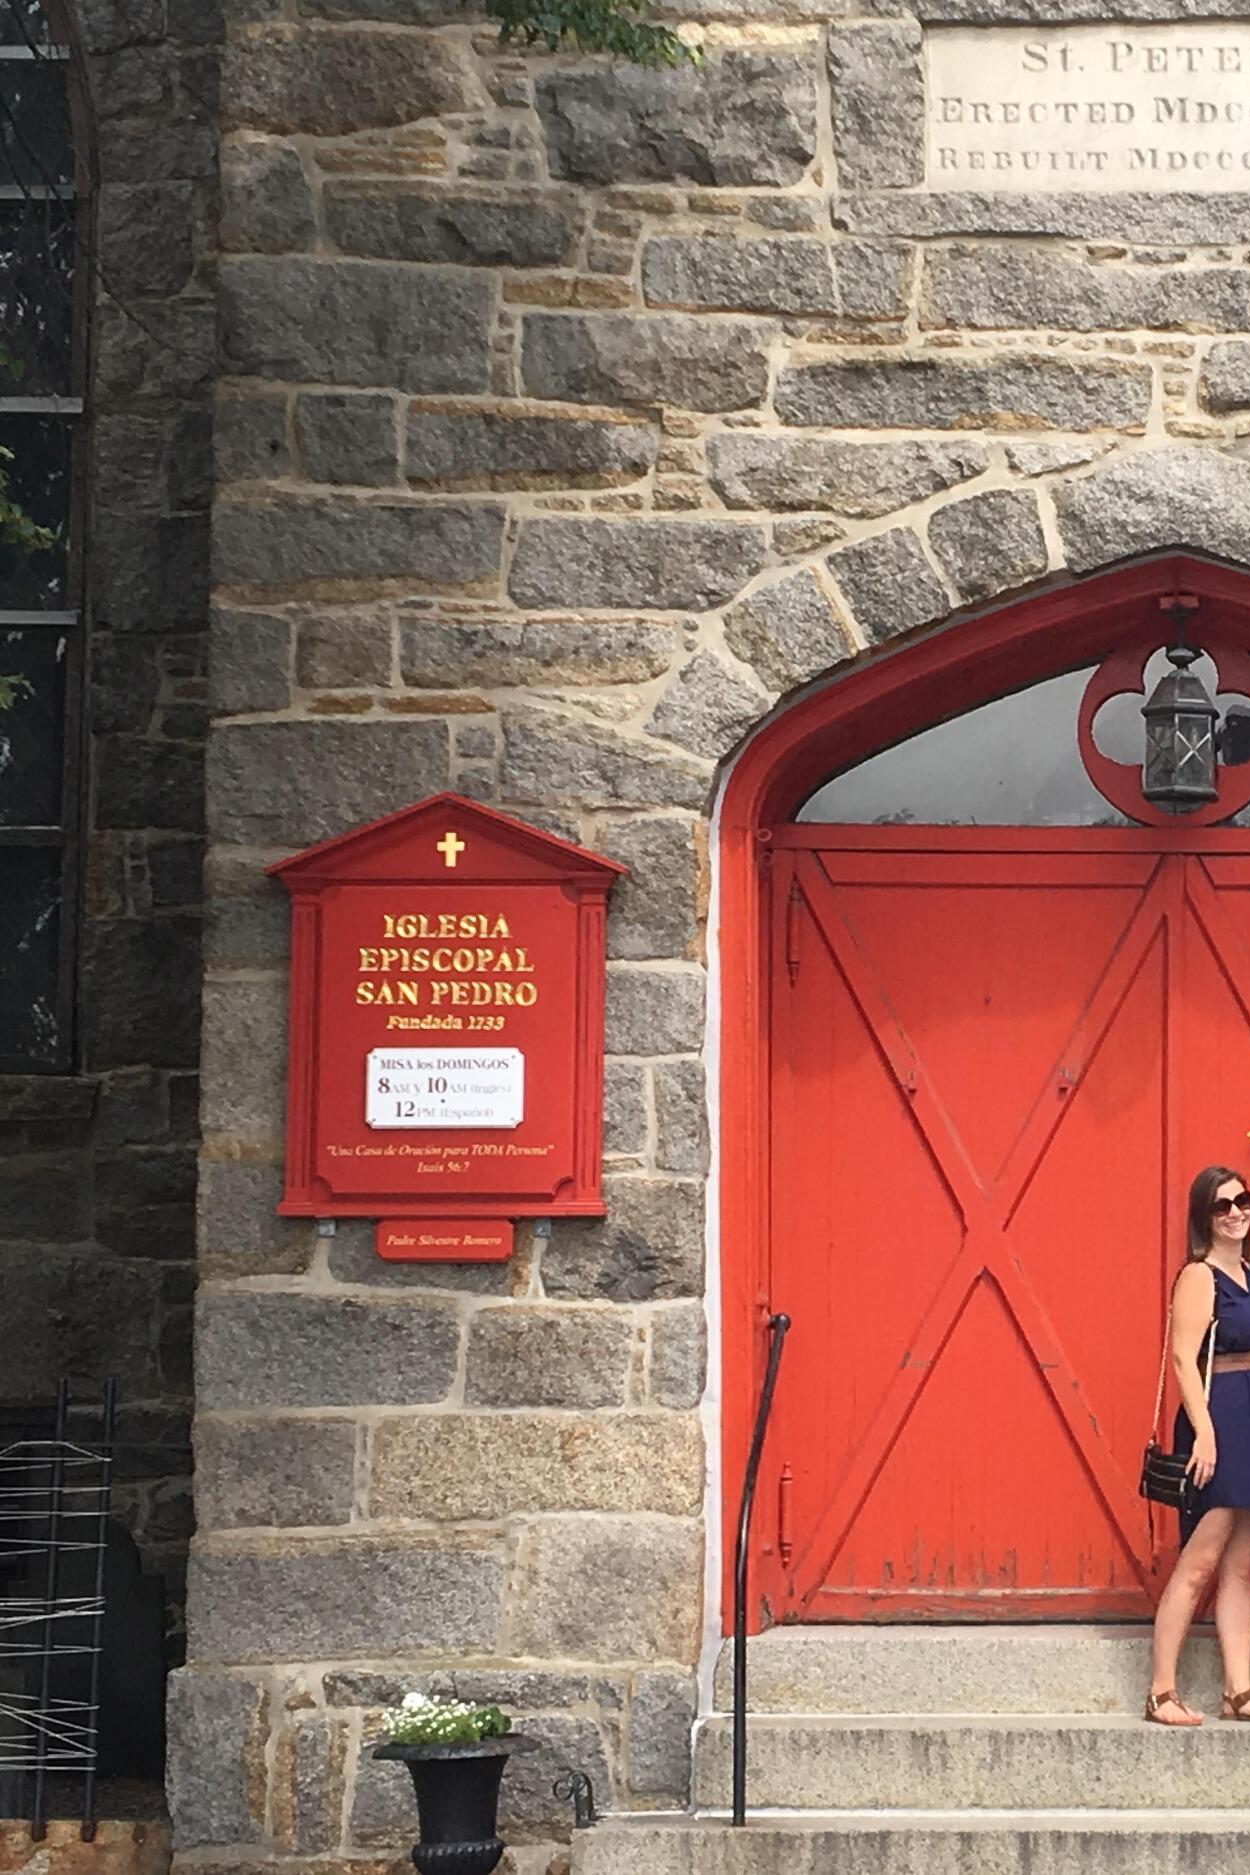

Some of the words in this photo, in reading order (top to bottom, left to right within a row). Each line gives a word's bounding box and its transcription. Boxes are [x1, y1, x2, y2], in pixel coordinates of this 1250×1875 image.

[1022, 42, 1085, 73] St.
[938, 98, 1135, 123] ERECTED
[938, 148, 1108, 170] REBUILT
[384, 913, 512, 938] IGLESIA
[358, 947, 534, 972] EPISCOPAL
[356, 980, 418, 1005] SAN
[430, 982, 538, 1006] PEDRO
[387, 1014, 462, 1030] Fundada
[467, 1015, 505, 1030] 1733
[380, 1058, 413, 1070] MISA
[417, 1058, 433, 1070] los
[437, 1058, 509, 1070] DOMINGOS
